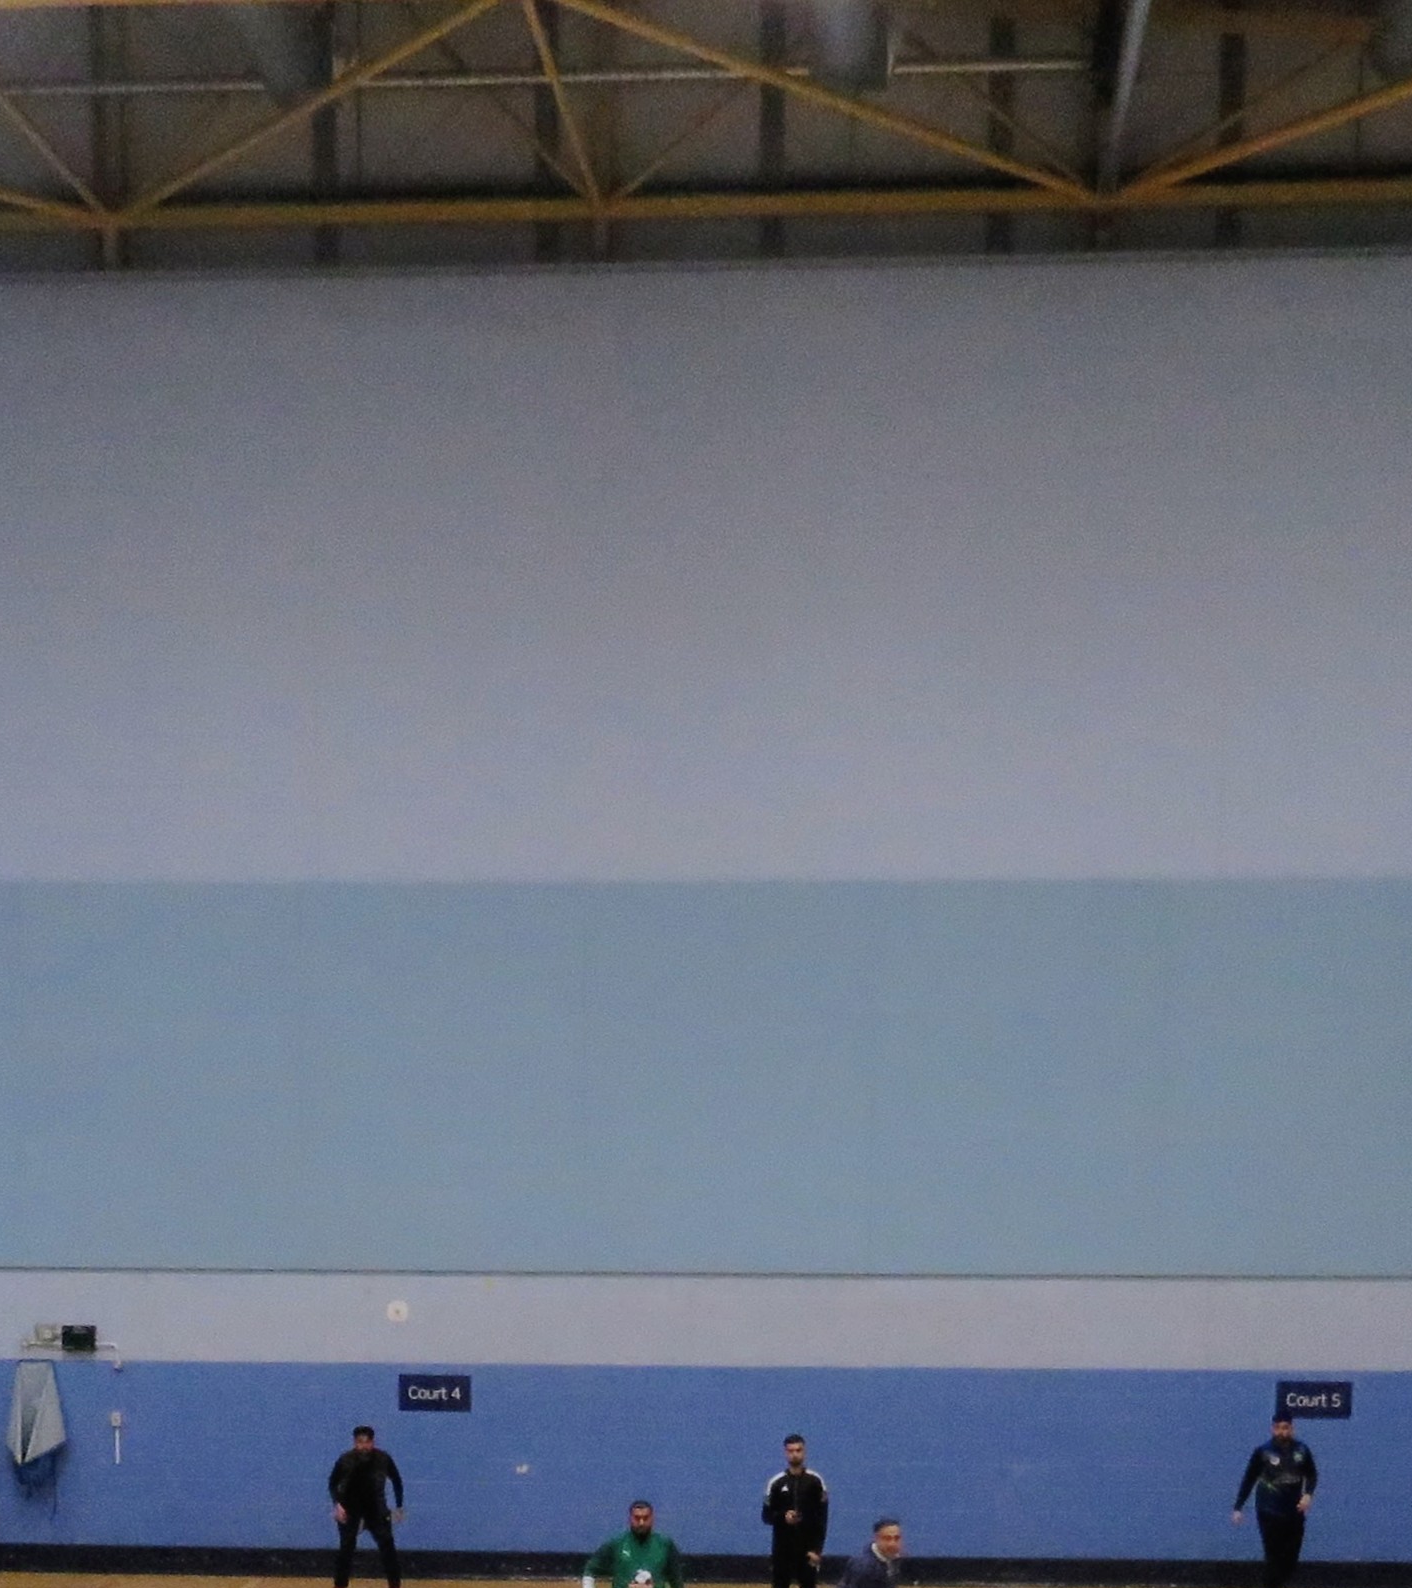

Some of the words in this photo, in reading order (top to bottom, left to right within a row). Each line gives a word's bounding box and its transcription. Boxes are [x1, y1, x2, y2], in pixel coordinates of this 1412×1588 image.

[408, 1385, 448, 1400] Court
[450, 1386, 461, 1400] 4
[1286, 1393, 1327, 1407] Court
[1330, 1393, 1341, 1408] 5
